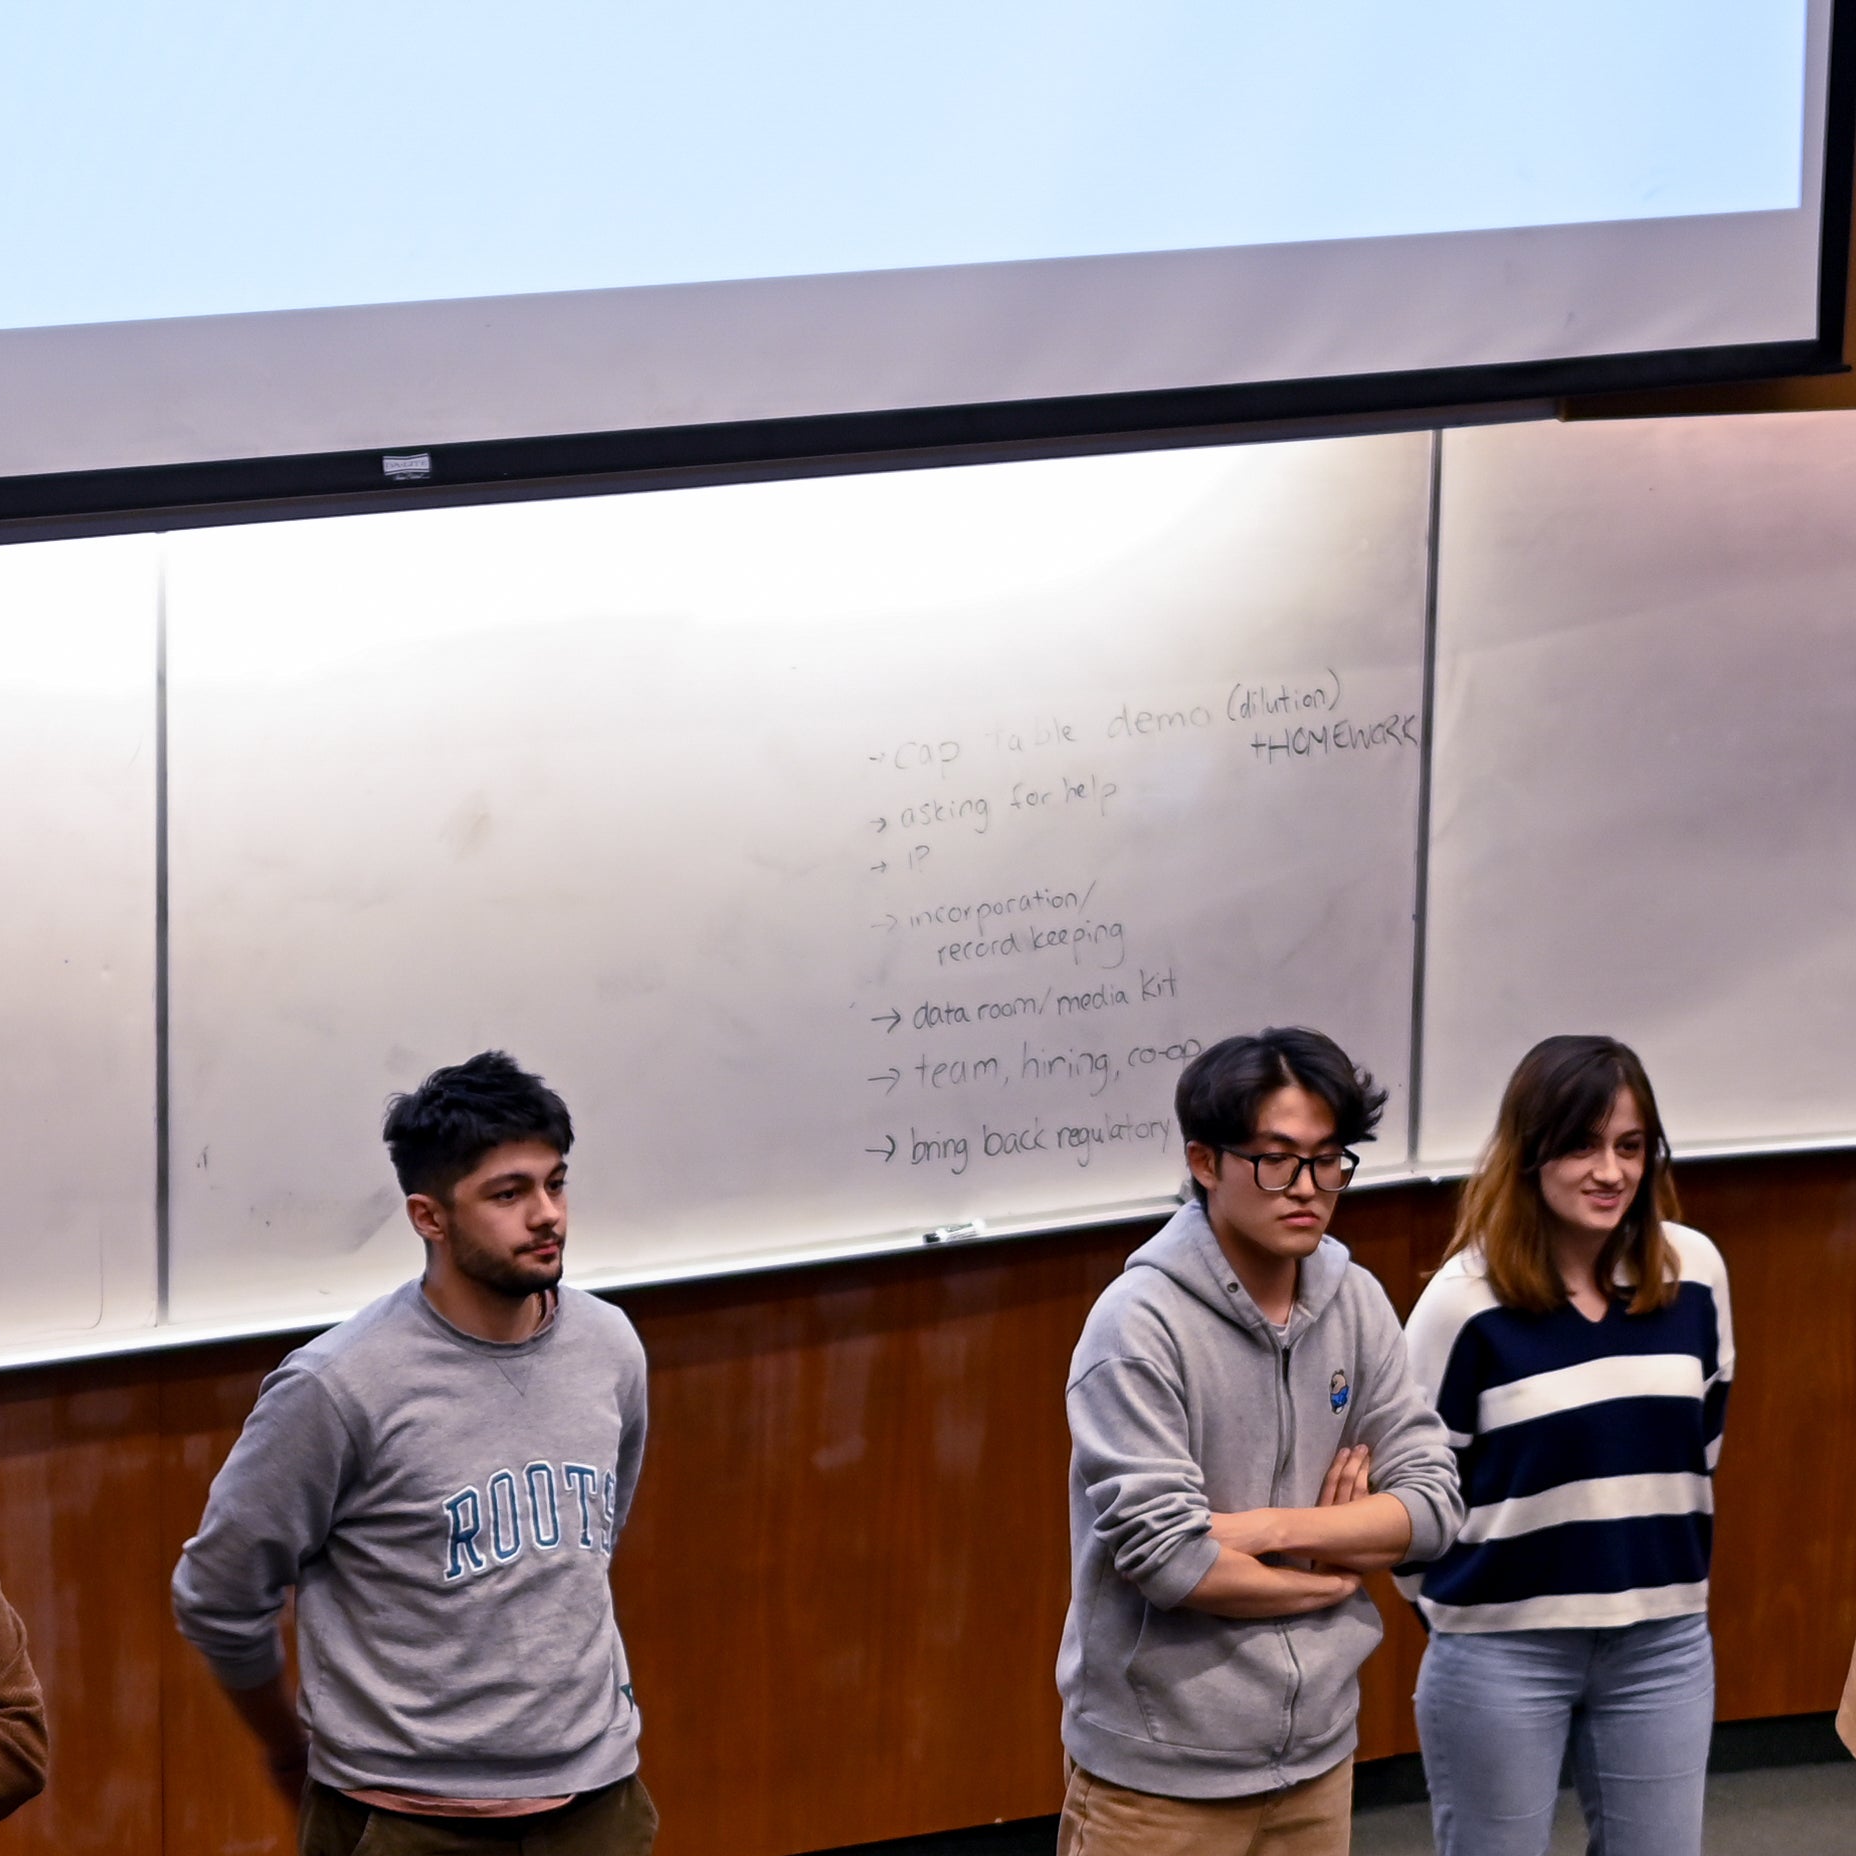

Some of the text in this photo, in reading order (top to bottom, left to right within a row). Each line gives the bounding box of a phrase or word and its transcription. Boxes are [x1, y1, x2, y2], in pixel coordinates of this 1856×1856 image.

[1107, 703, 1213, 739] demo
[1227, 667, 1341, 722] (dilution)
[901, 773, 1117, 834] asking for help
[937, 919, 1126, 969] record keeping
[915, 1053, 1009, 1089] team,
[1021, 1041, 1120, 1097] hiring,
[911, 1112, 1173, 1175] bring back regulatory
[444, 1460, 616, 1581] ROOTS
